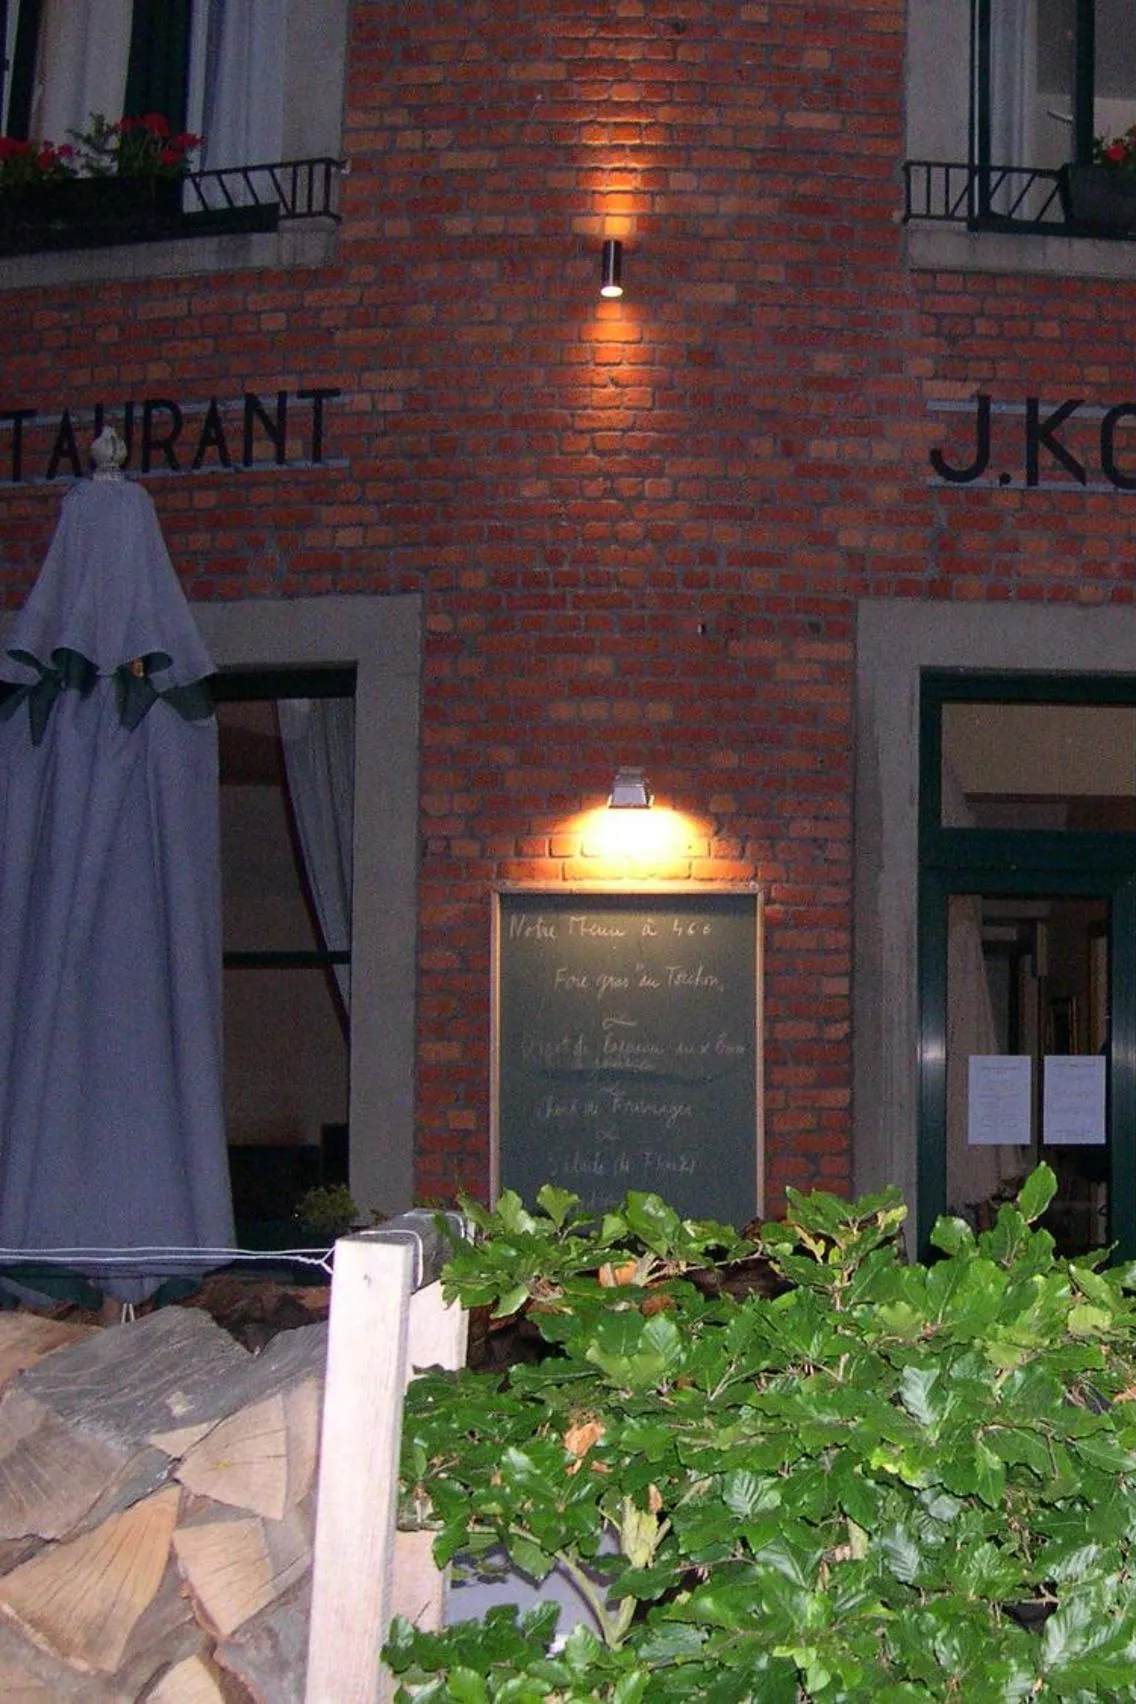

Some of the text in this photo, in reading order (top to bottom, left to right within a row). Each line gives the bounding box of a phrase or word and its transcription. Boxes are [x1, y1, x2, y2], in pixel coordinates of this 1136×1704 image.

[0, 388, 341, 482] TAURANT
[508, 913, 557, 940] Notre
[568, 915, 626, 938] Menu
